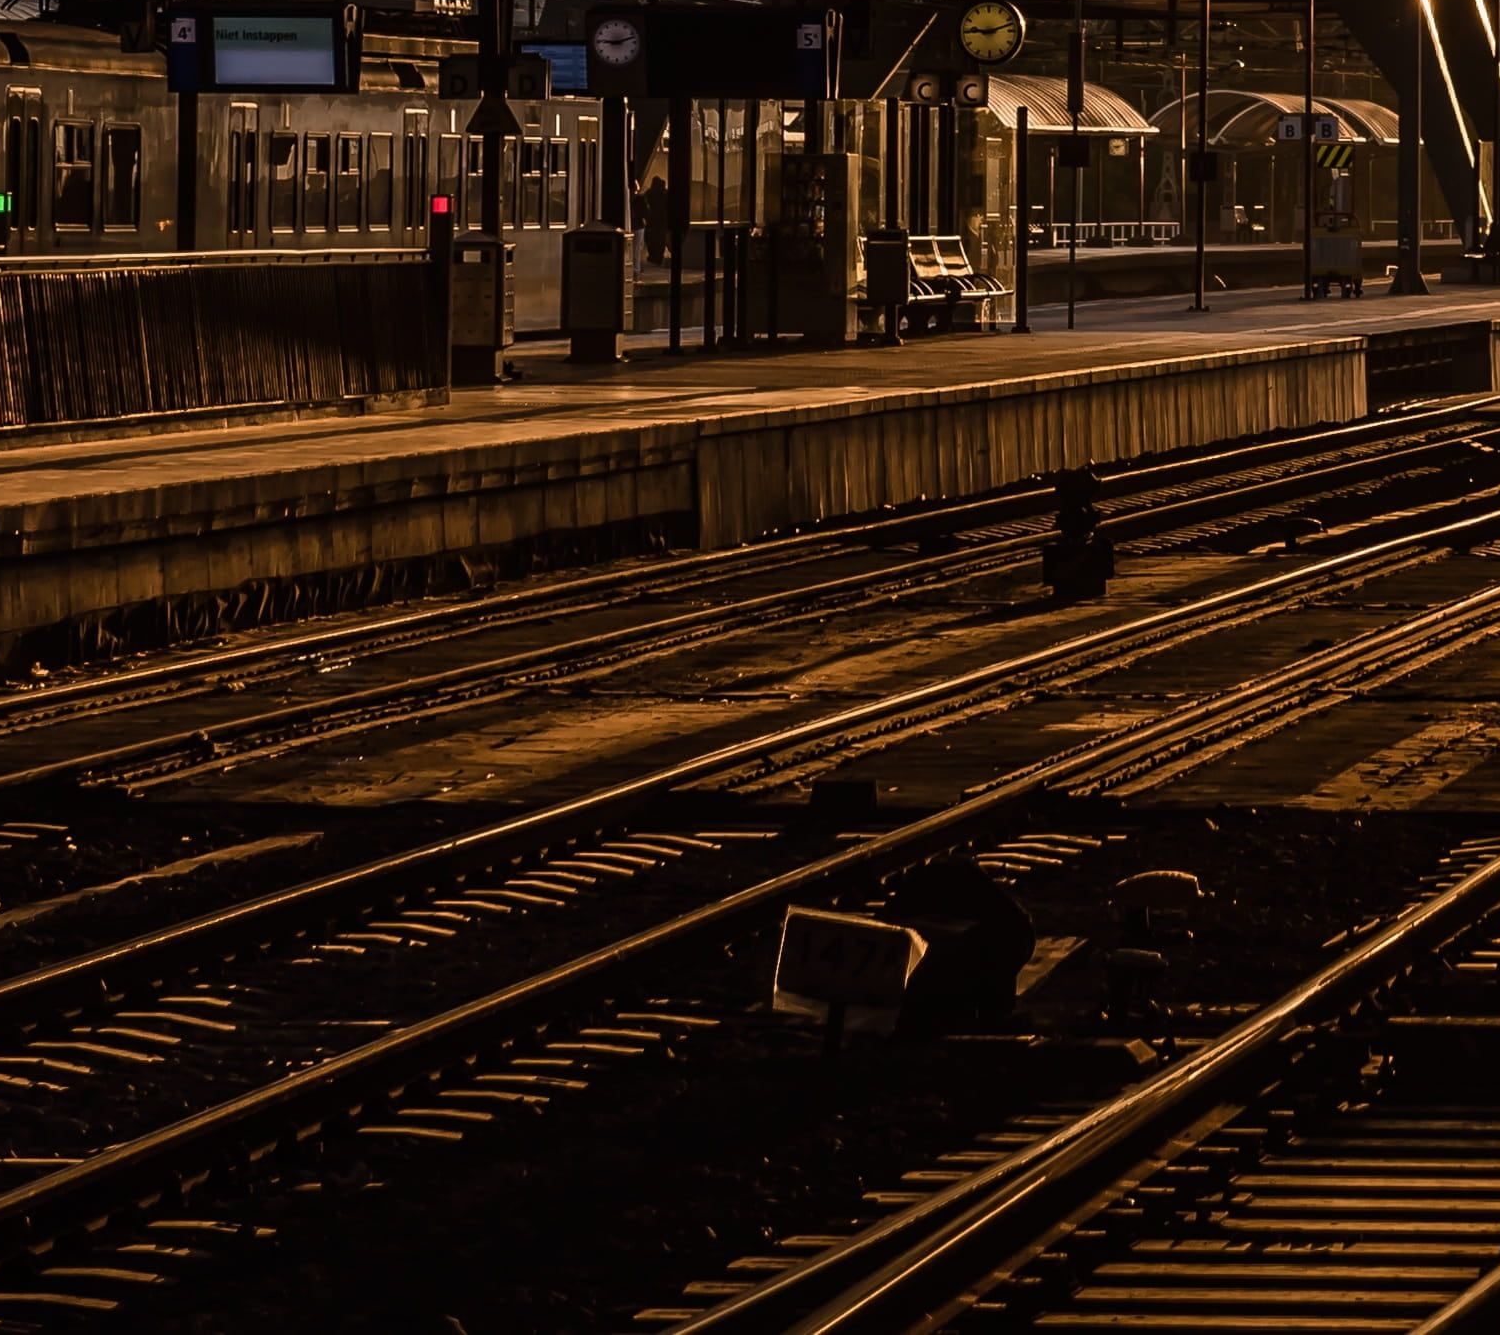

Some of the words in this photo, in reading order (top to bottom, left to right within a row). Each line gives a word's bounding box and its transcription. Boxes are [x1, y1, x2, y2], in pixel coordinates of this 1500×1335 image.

[215, 29, 239, 41] Niet
[450, 75, 467, 96] D
[518, 74, 536, 96] D
[918, 82, 932, 100] C
[963, 83, 977, 102] C
[1285, 125, 1295, 138] B
[1322, 124, 1332, 138] B
